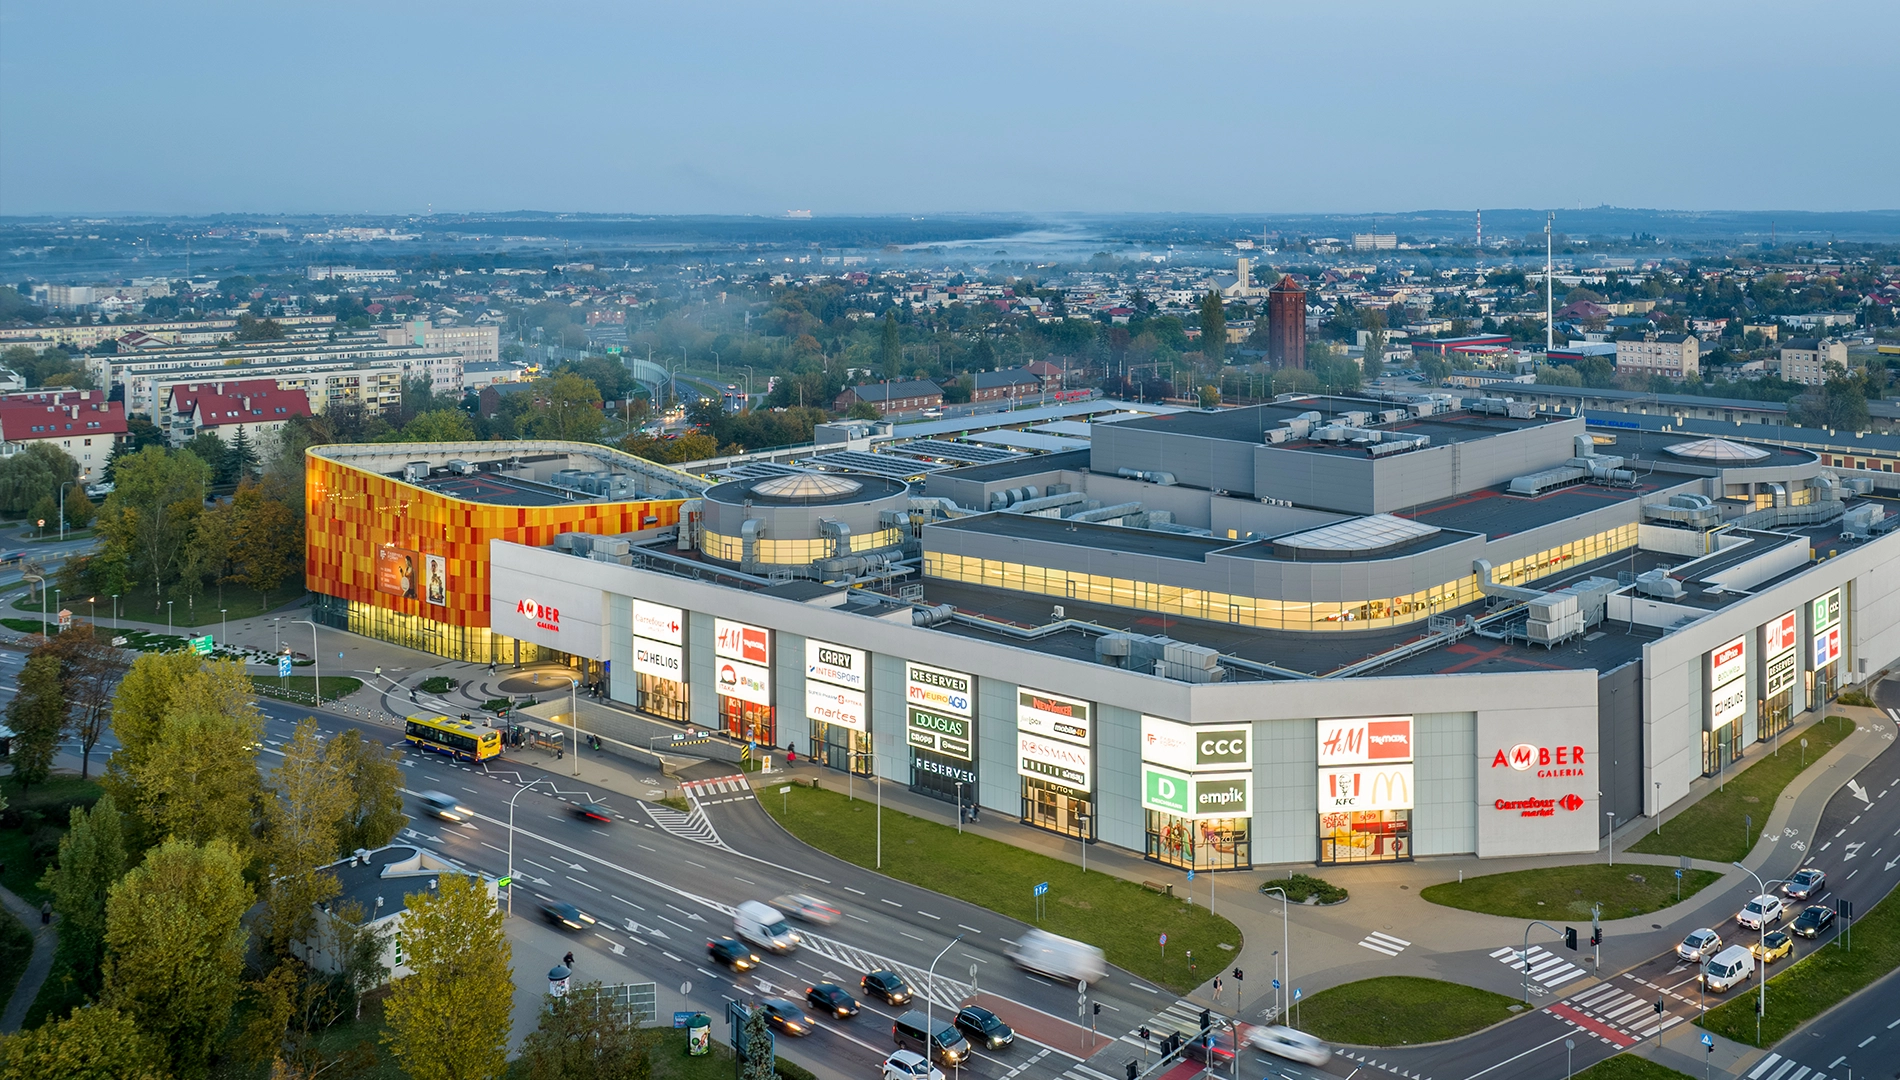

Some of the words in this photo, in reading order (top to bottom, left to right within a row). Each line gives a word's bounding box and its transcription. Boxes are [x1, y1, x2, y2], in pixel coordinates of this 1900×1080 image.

[516, 599, 560, 623] AMBER
[635, 613, 665, 628] Carrefour
[649, 652, 679, 670] HELIOS
[820, 649, 850, 668] CARRY
[816, 666, 860, 684] INTERSPORT
[912, 669, 966, 691] RESERVED
[814, 706, 857, 724] martes
[915, 712, 962, 736] DOUGLAS
[911, 732, 933, 745] CROPP
[1201, 739, 1243, 756] CCC
[1322, 727, 1364, 756] H&M
[1021, 739, 1086, 765] ROSSMANN
[1491, 745, 1585, 768] AMBER
[916, 758, 976, 783] RESERVED
[1537, 768, 1584, 778] GALERIA
[1200, 787, 1243, 805] empik
[1335, 797, 1355, 806] KFC
[1495, 797, 1555, 811] Carrefour
[1322, 813, 1349, 823] SNACK
[1521, 808, 1555, 818] market
[1326, 820, 1346, 829] DEAL
